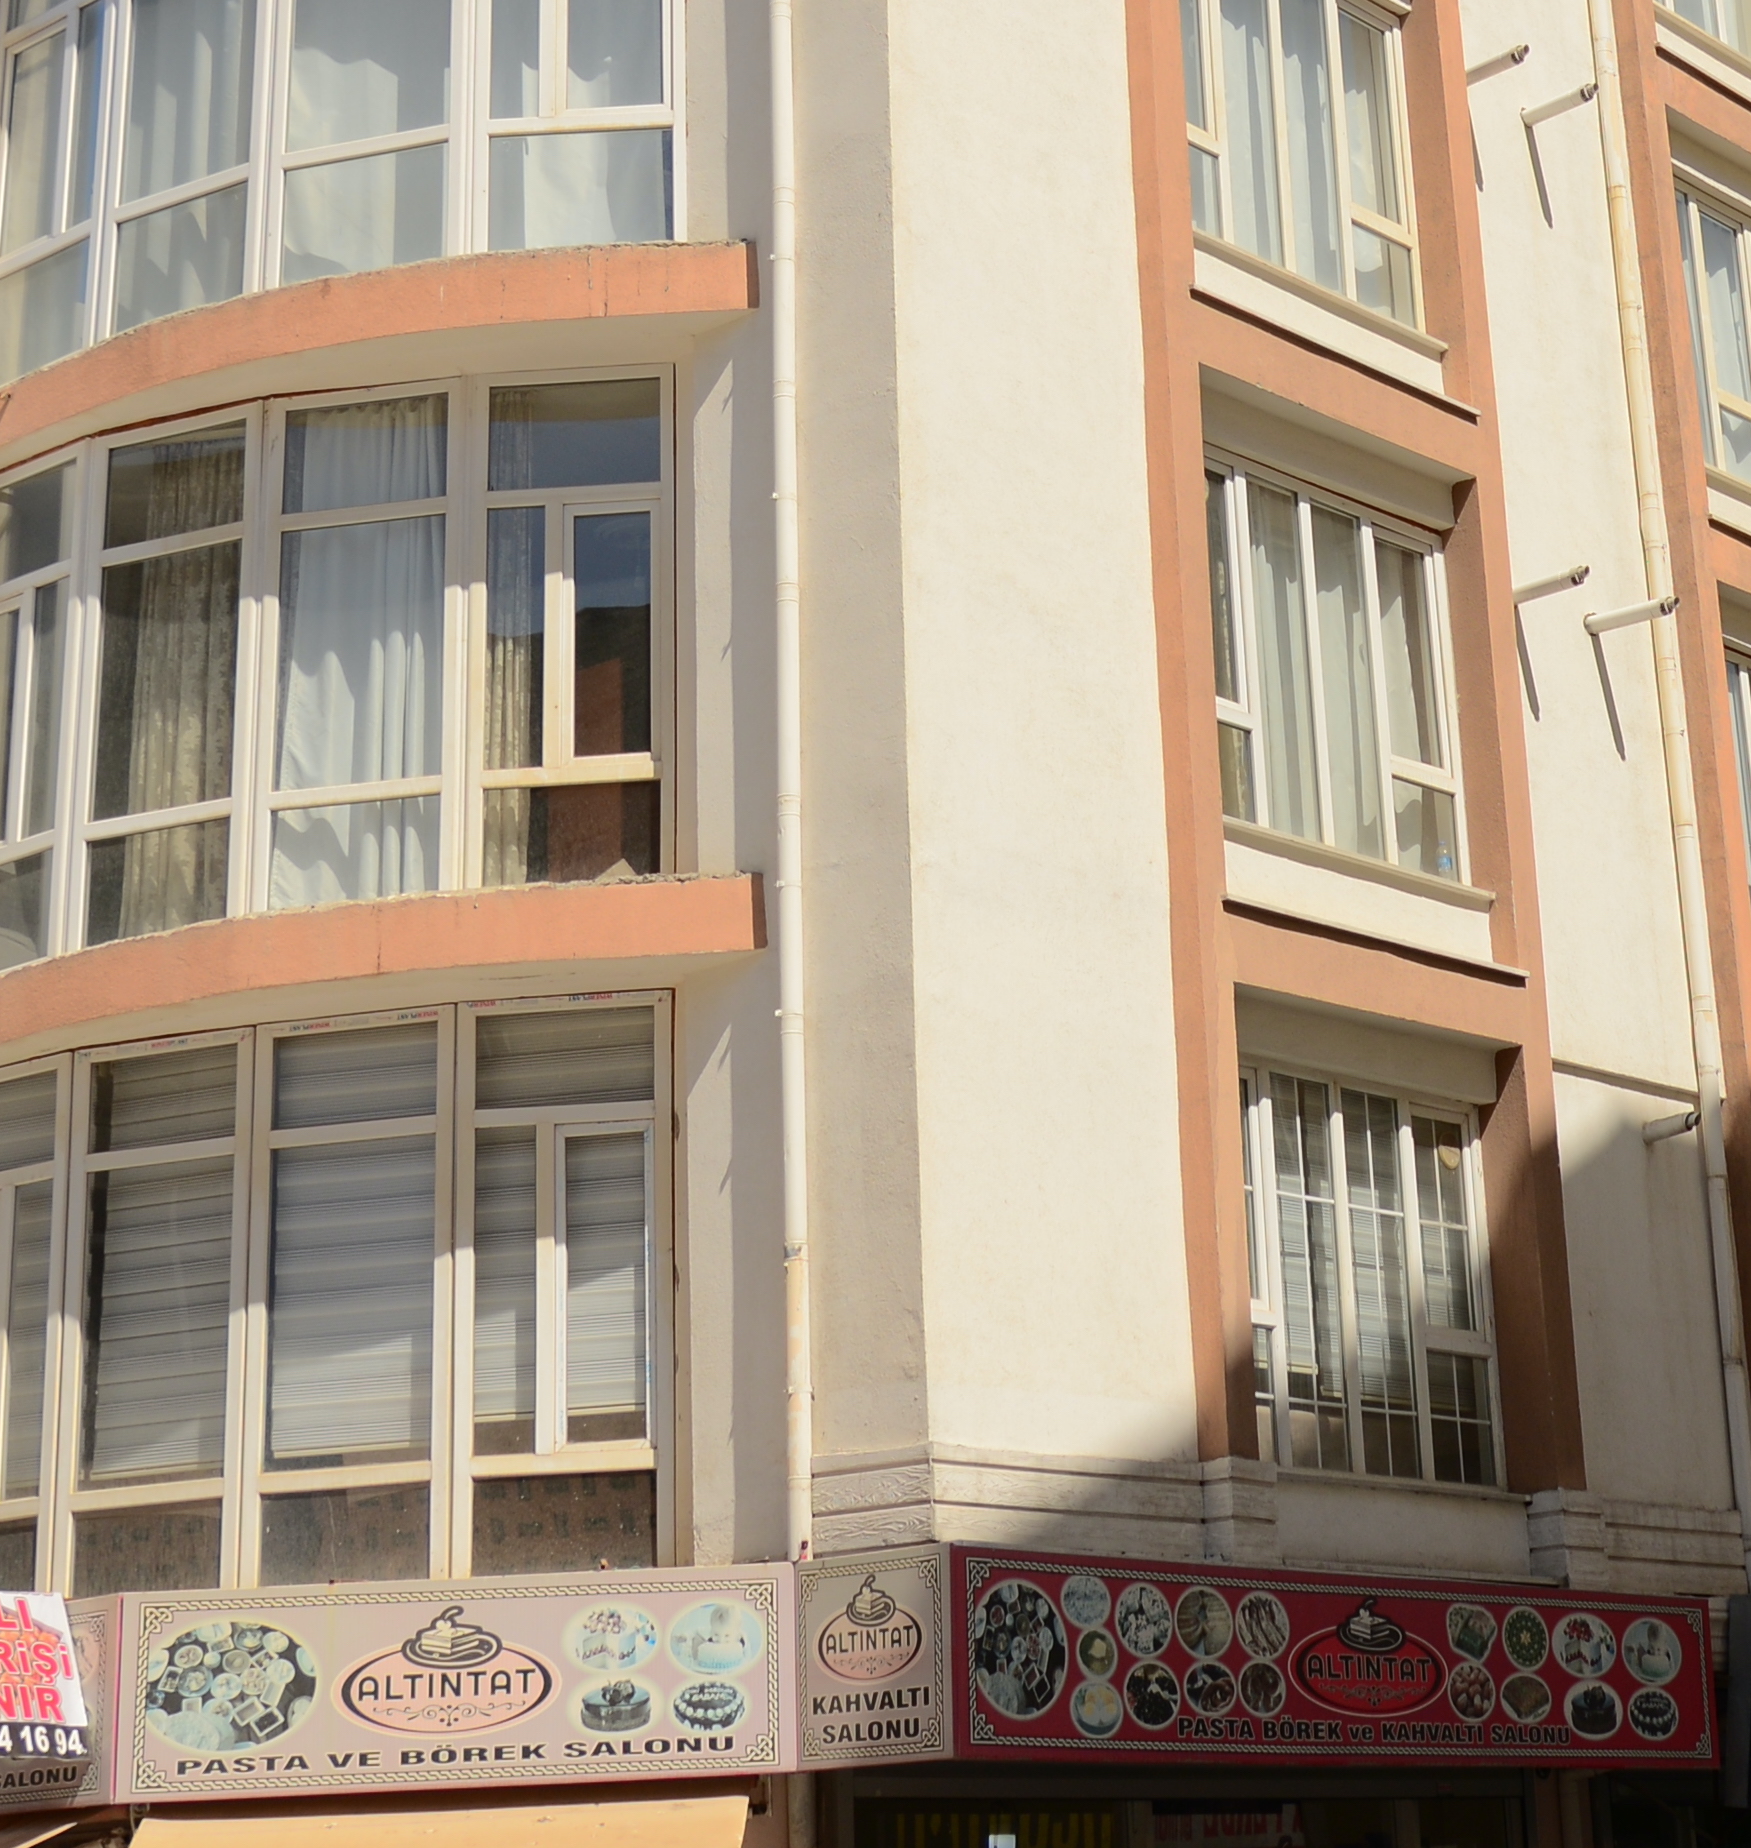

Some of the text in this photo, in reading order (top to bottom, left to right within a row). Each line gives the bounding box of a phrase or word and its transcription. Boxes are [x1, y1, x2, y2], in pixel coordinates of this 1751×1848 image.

[826, 1625, 913, 1655] ALTINTAT
[1307, 1653, 1432, 1682] ALTINTAT
[358, 1667, 538, 1701] ALTINTAT
[812, 1686, 930, 1715] KAHVALTI
[20, 1726, 49, 1752] 16
[822, 1717, 920, 1744] SALONU
[1178, 1716, 1570, 1745] PASTA BÖREK ve KAHVALTI SALONU
[176, 1735, 735, 1776] PASTA VE BÖREK SALONU
